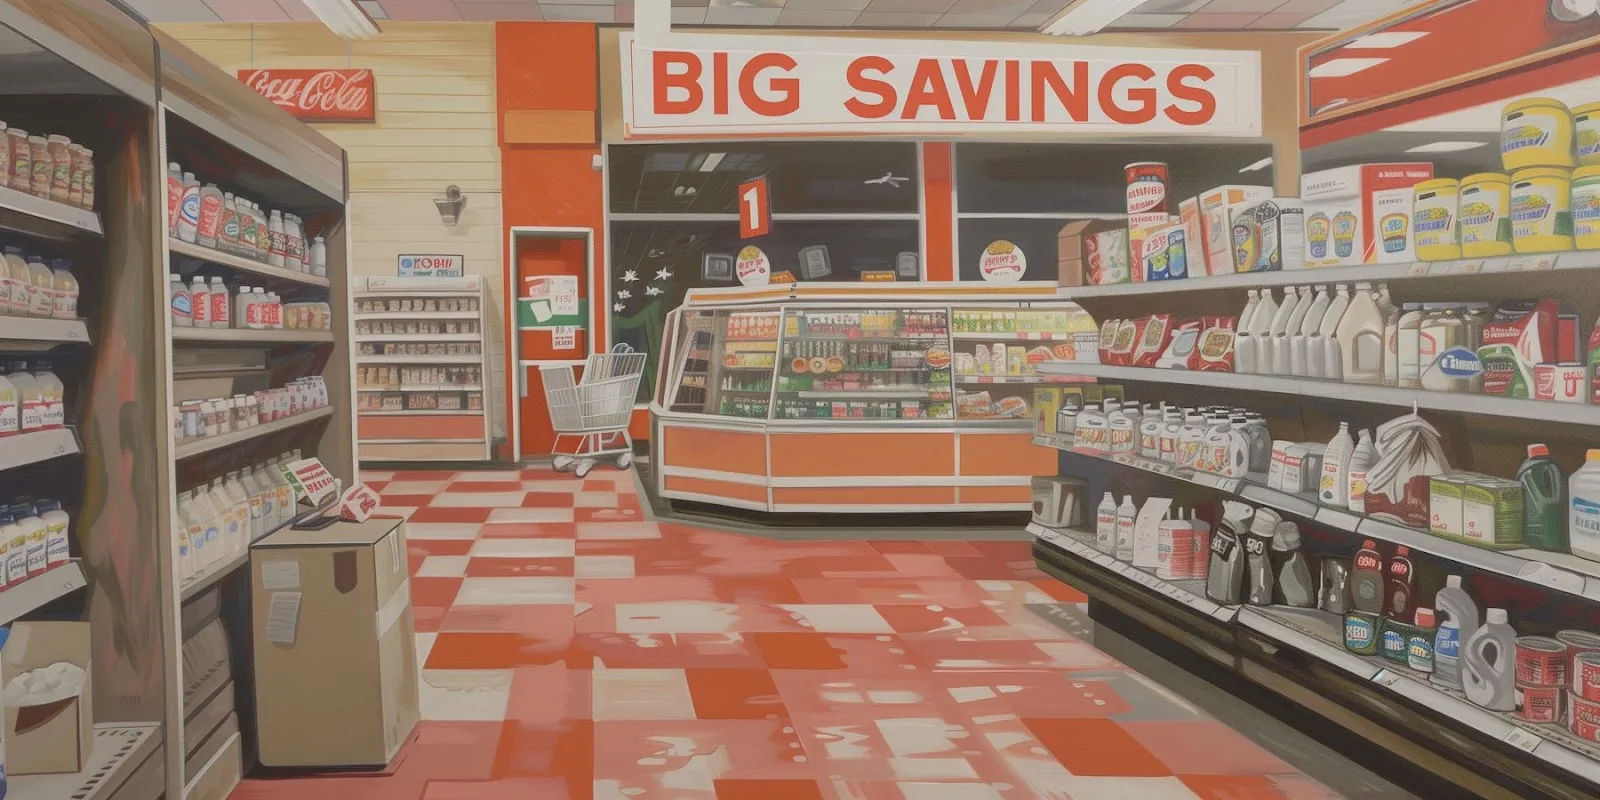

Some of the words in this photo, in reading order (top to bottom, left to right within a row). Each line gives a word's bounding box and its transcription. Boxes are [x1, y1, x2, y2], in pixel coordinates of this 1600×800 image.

[246, 67, 368, 111] Coca-Cola
[652, 50, 800, 118] BIG
[844, 55, 1217, 126] SAVINGS
[743, 186, 760, 230] 1
